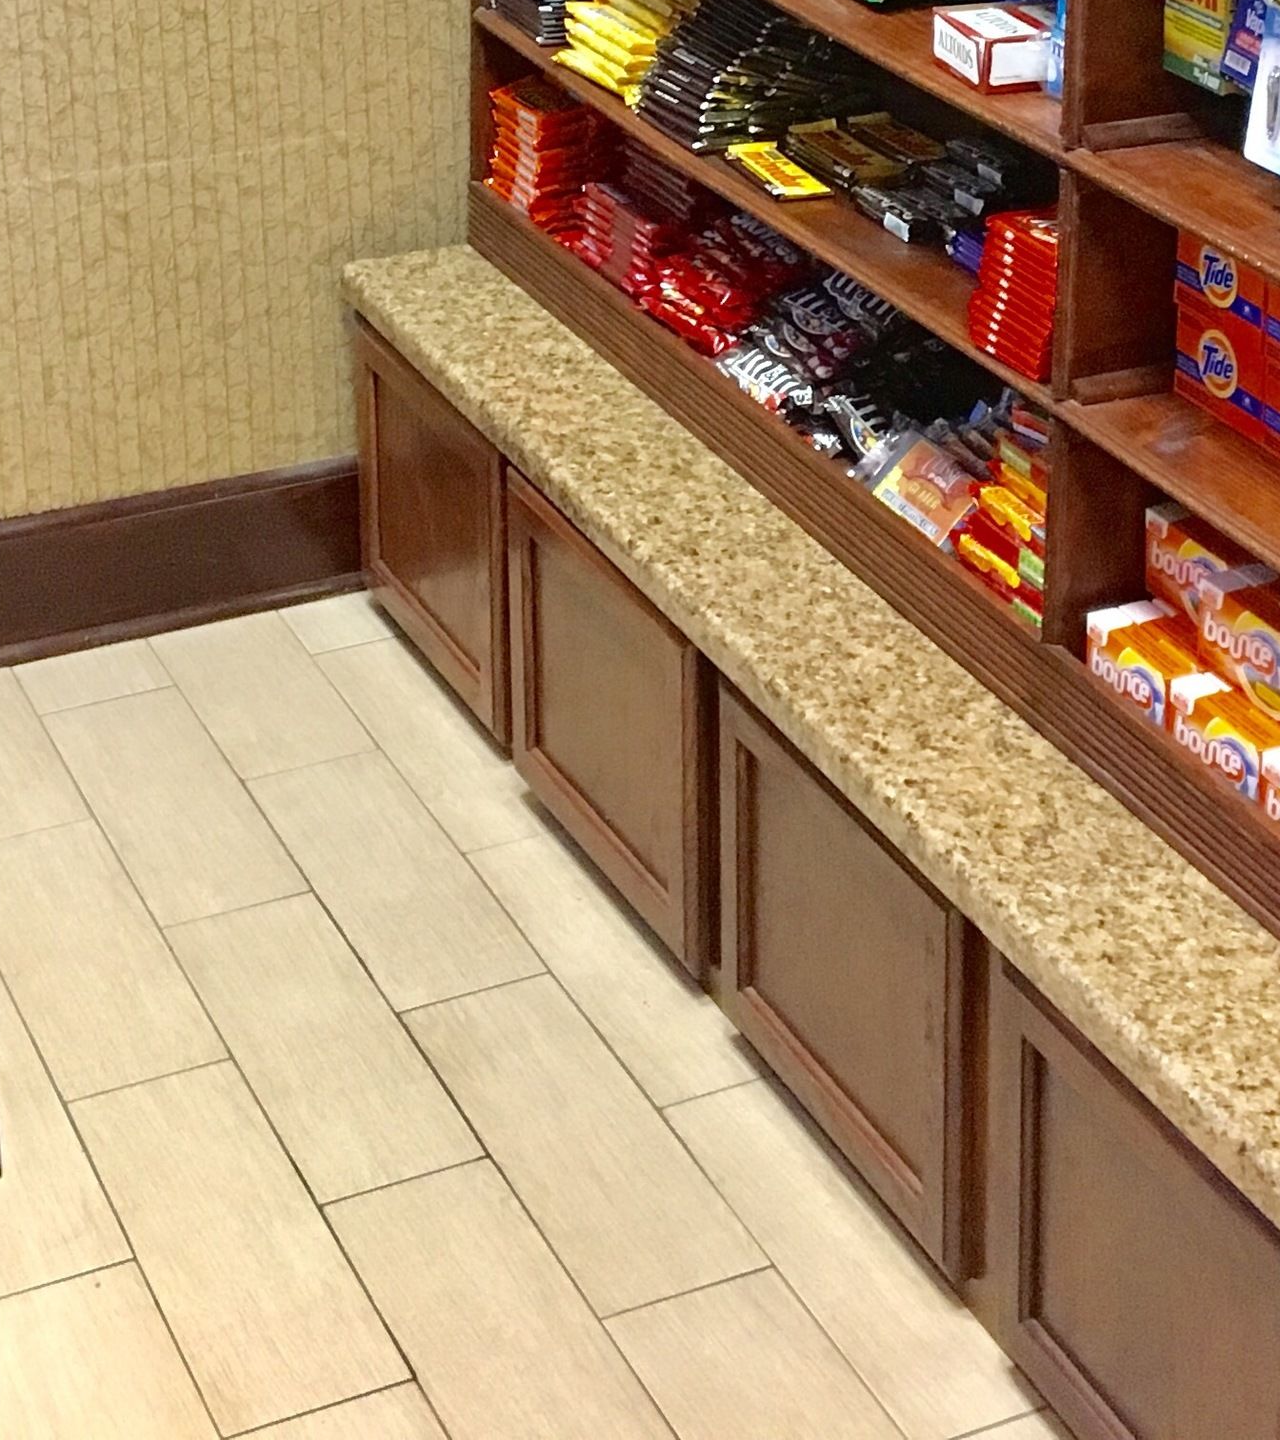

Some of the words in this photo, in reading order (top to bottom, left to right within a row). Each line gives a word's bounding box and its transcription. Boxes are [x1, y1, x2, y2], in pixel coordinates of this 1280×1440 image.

[938, 29, 975, 70] ALTOIDS
[1202, 253, 1233, 288] Tide
[1202, 344, 1233, 379] Tide
[1151, 541, 1209, 586] bounc
[1203, 613, 1274, 670] bounce
[1091, 647, 1150, 704] bounce
[1174, 716, 1242, 776] bounce
